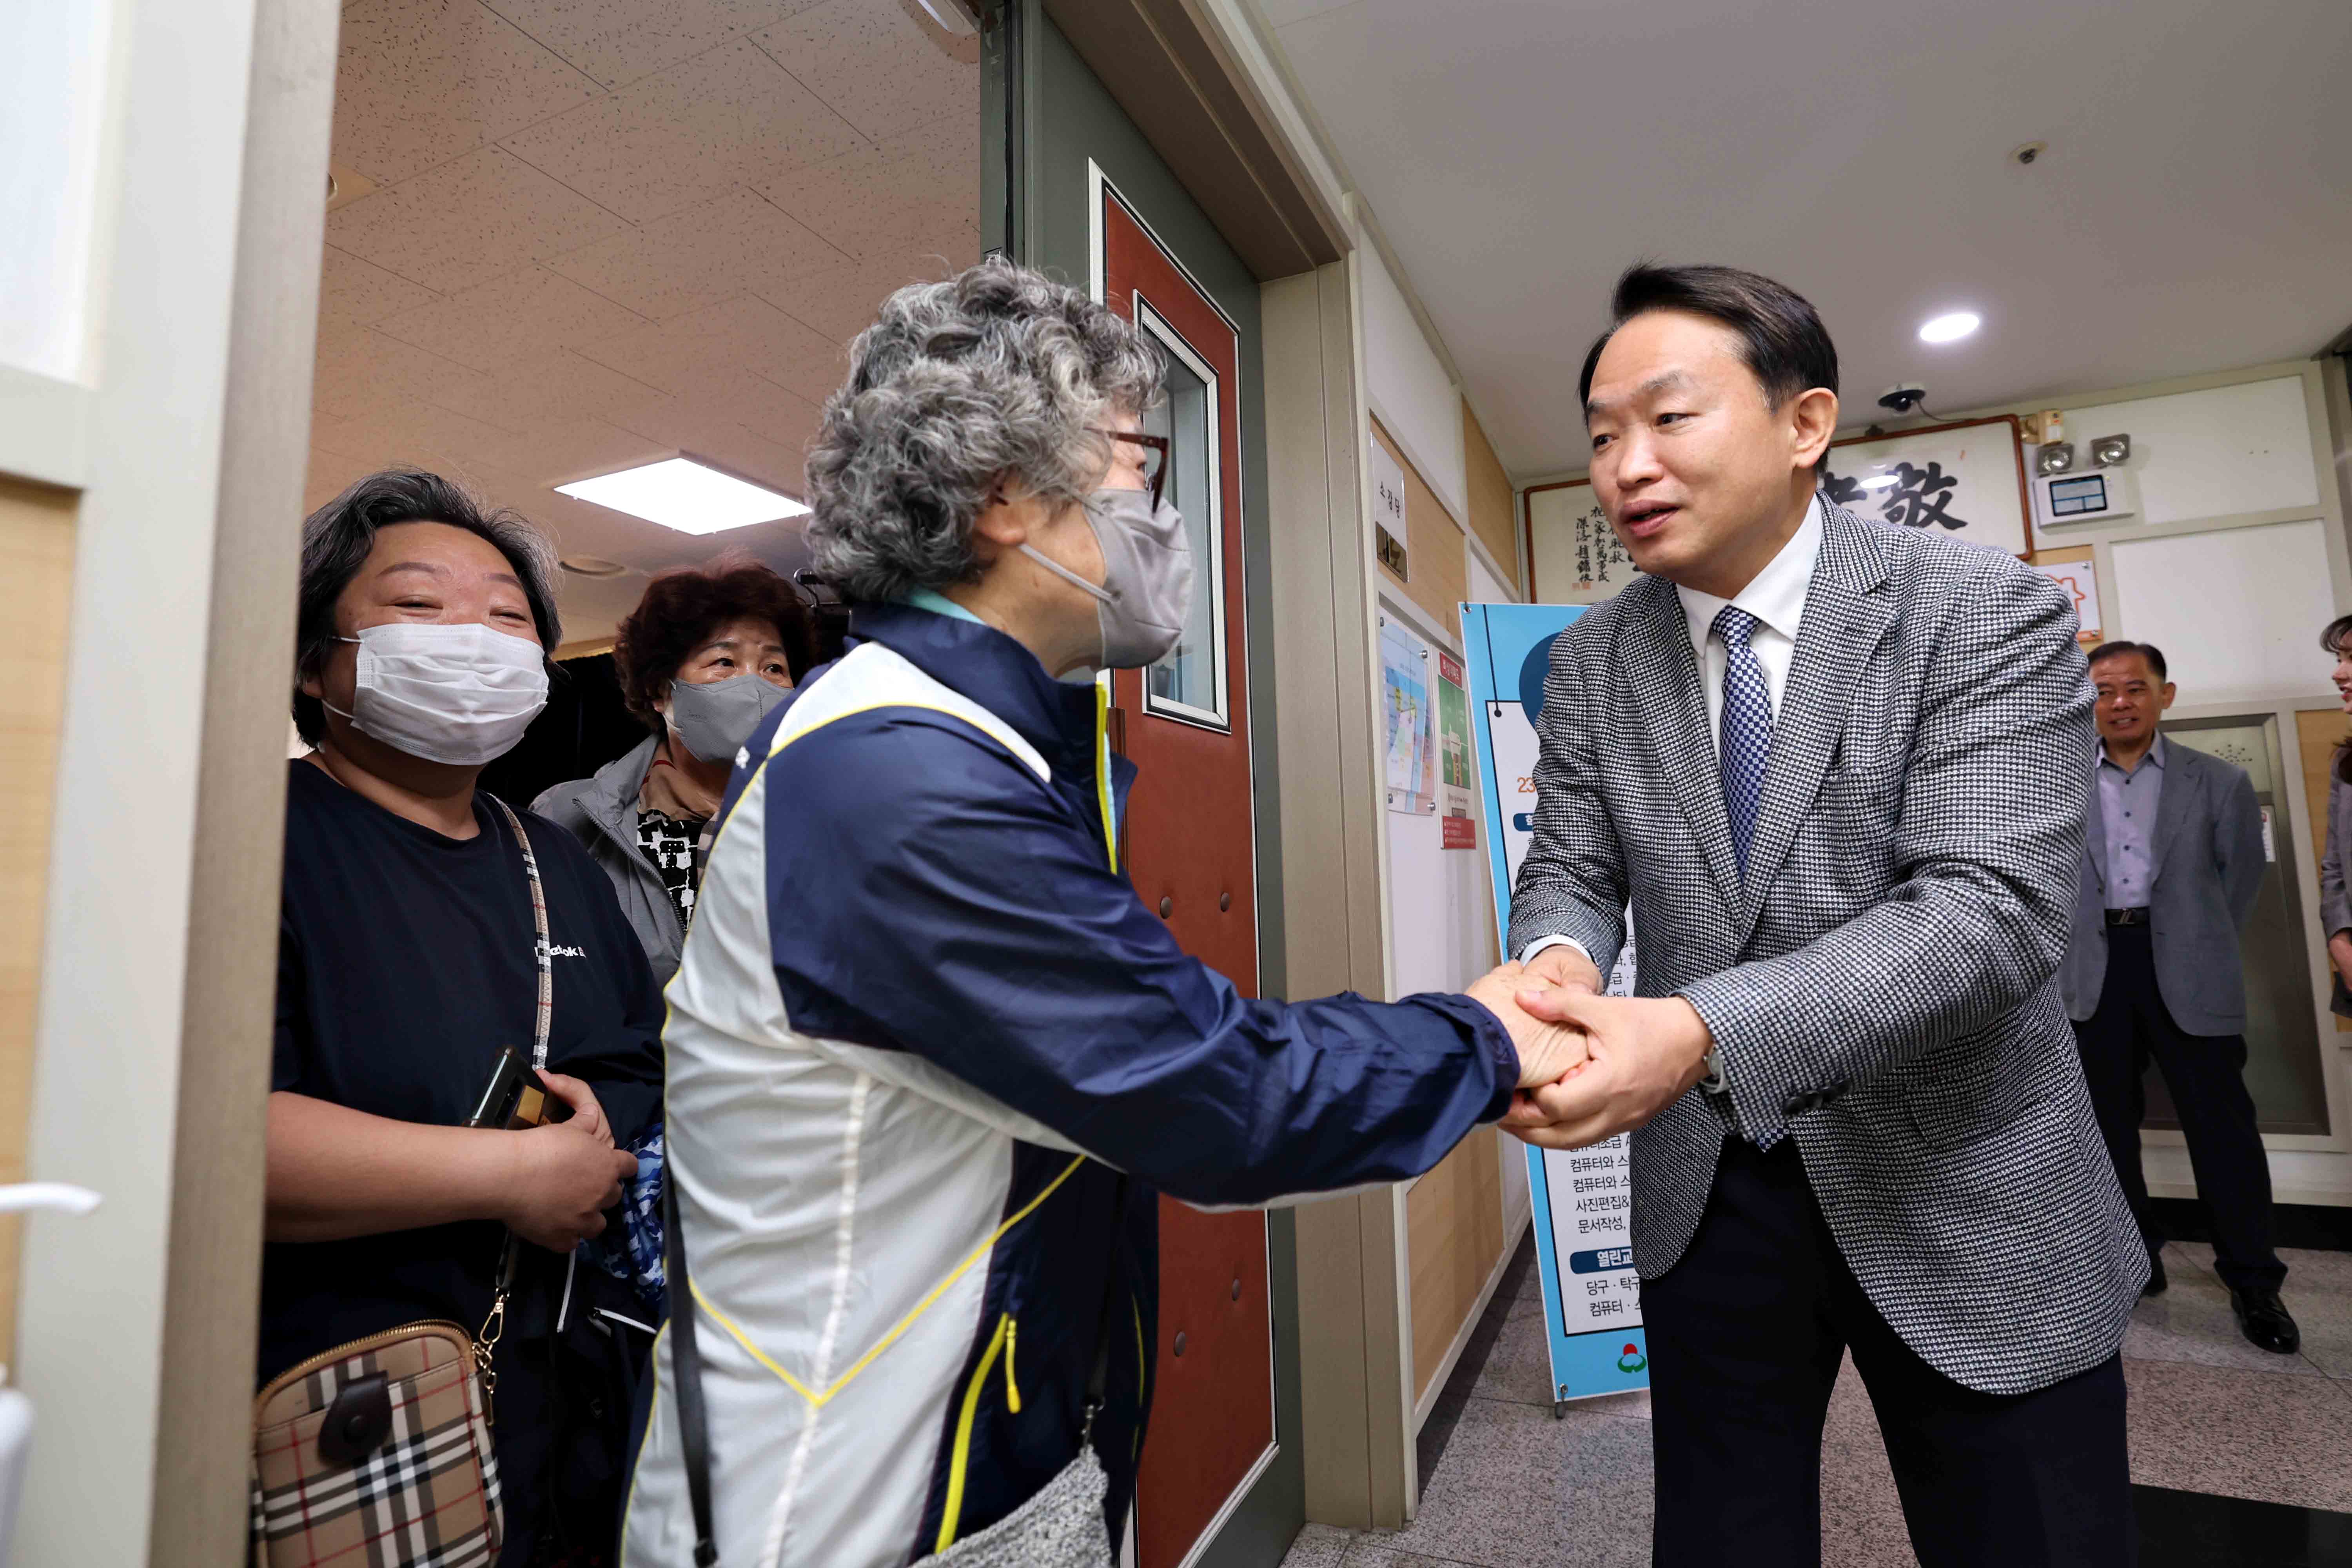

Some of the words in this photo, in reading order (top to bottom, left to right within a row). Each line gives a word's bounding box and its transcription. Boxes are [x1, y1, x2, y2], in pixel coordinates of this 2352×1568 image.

[1517, 777, 1535, 793] 23
[1570, 1156, 1614, 1172] 컴퓨터와
[1618, 1155, 1630, 1167] 스
[1573, 1175, 1617, 1193] 컴퓨터와
